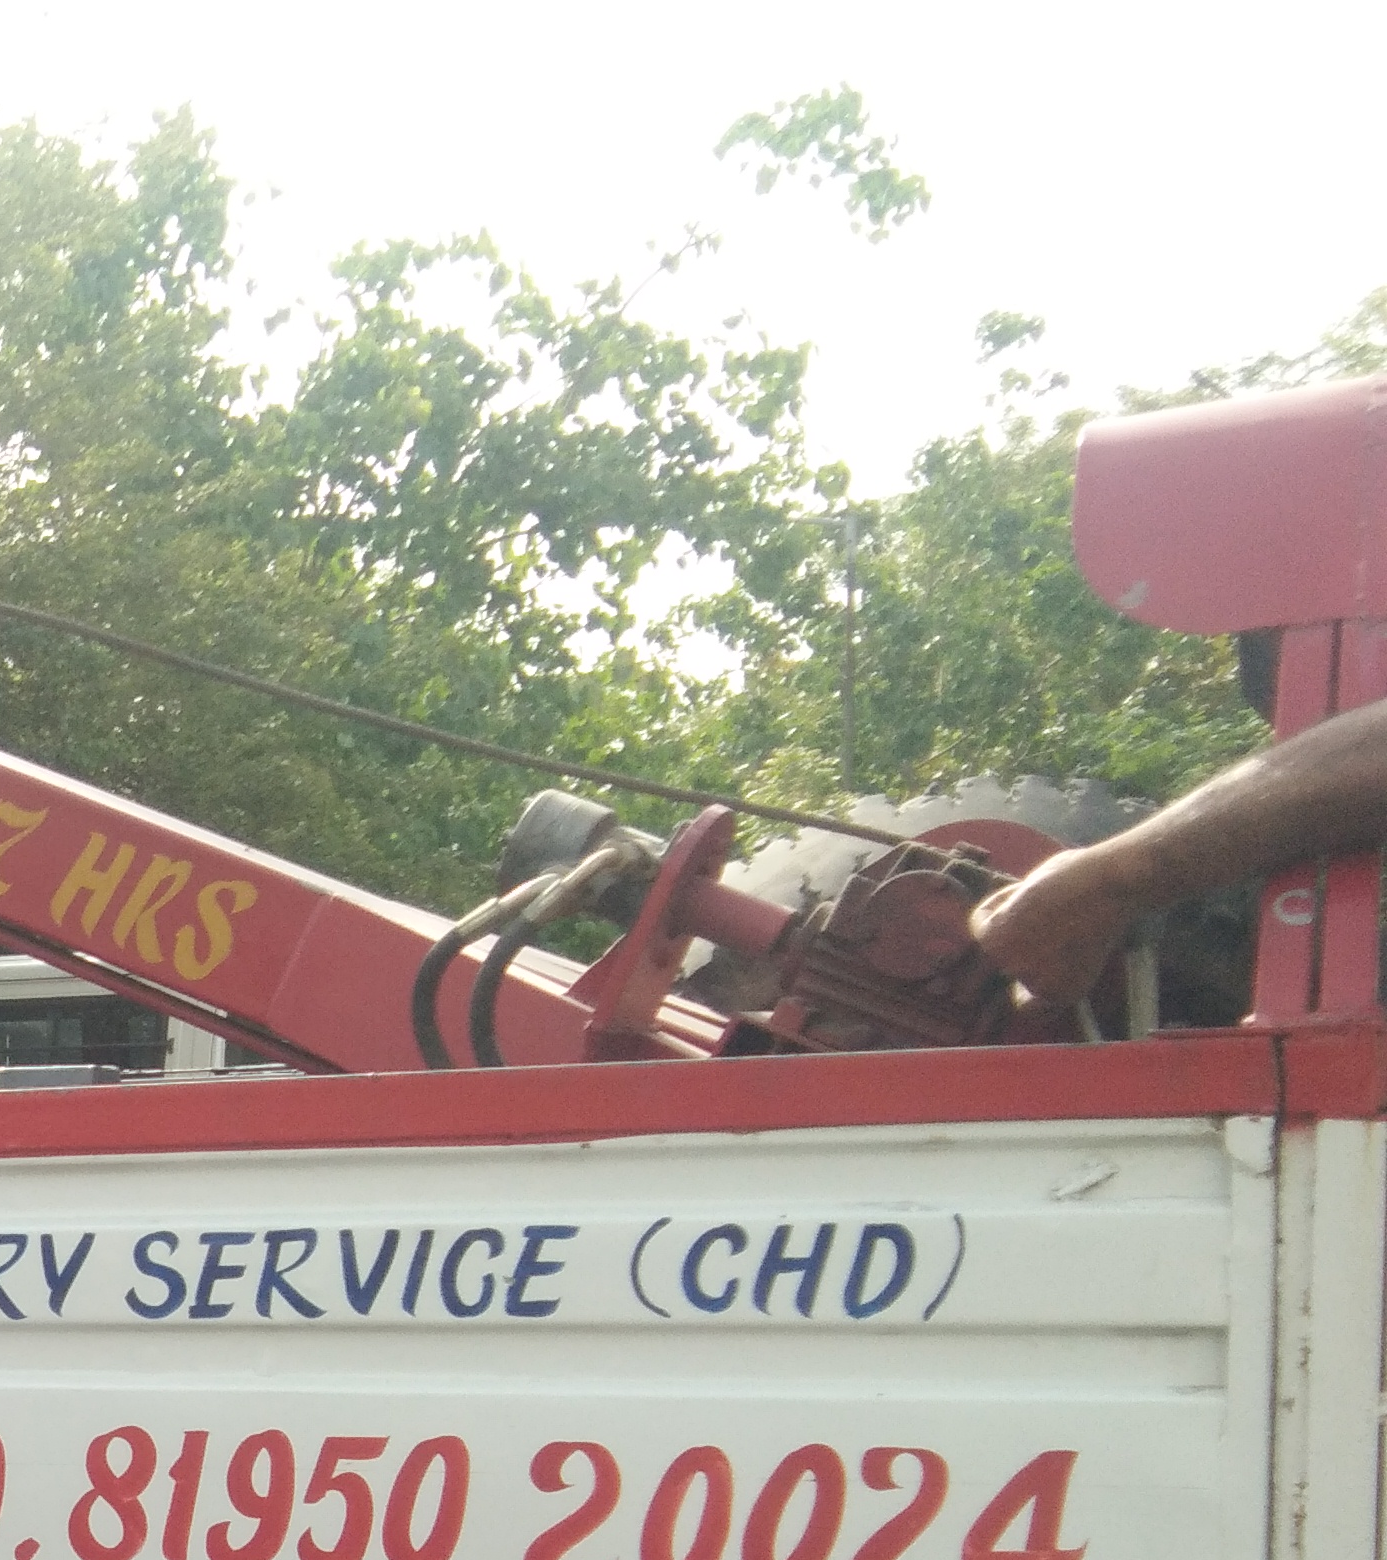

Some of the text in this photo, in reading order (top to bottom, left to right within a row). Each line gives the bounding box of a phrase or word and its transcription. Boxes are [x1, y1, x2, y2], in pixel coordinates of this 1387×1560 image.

[50, 830, 258, 981] HRS
[124, 1225, 579, 1320] SERVICE
[630, 1214, 966, 1321] (CHD)
